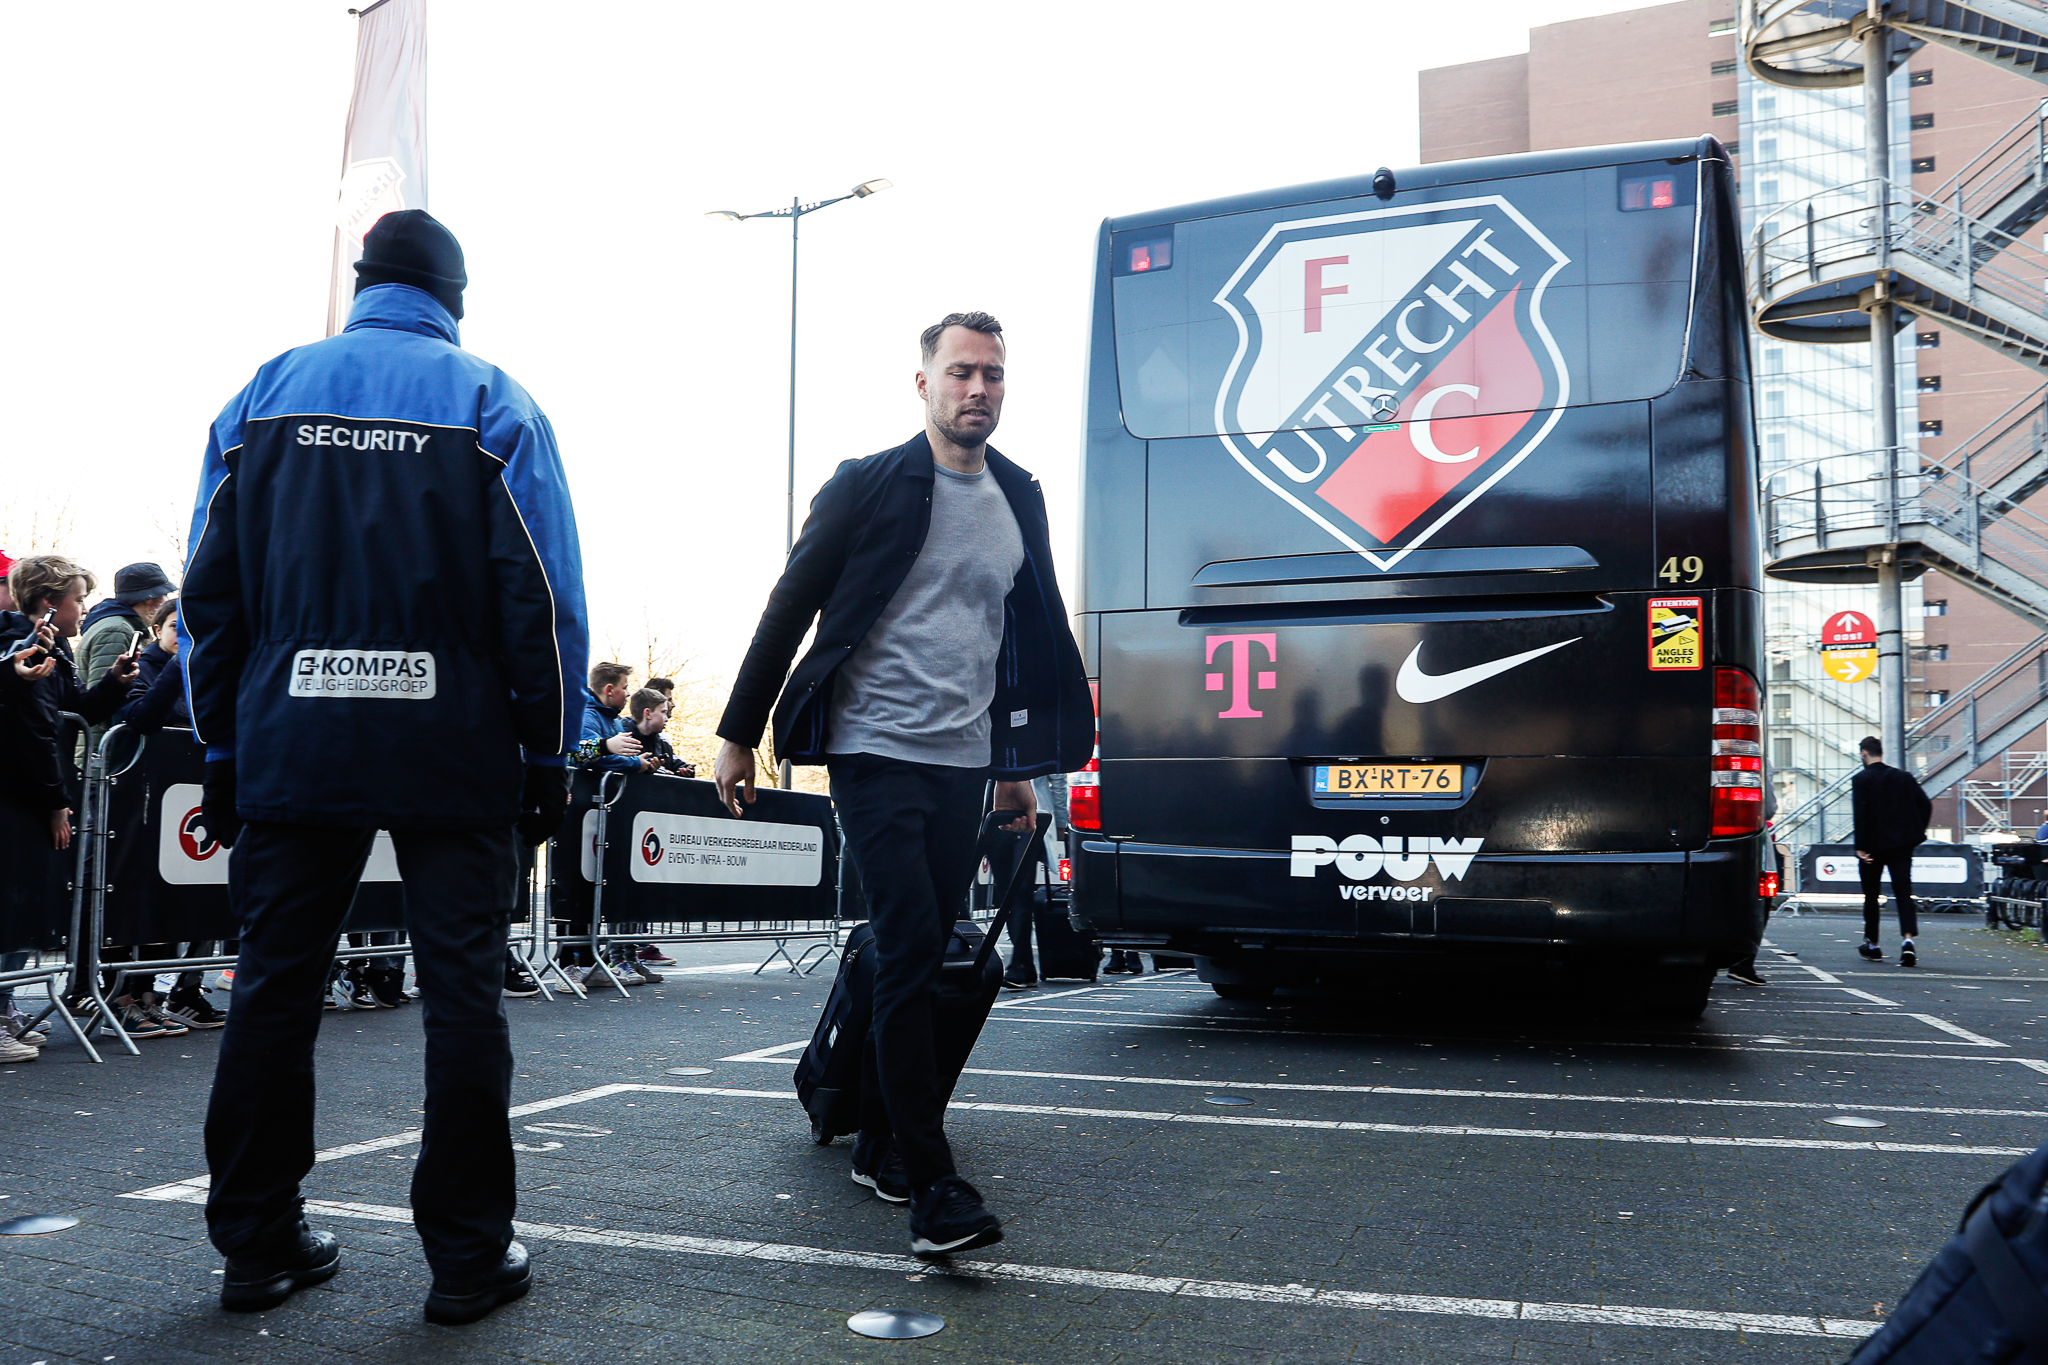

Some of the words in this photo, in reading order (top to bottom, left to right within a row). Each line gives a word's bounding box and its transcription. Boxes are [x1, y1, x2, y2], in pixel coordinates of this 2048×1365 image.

[1304, 255, 1349, 334] F
[1266, 227, 1520, 484] UTRECHT
[1409, 384, 1480, 464] C
[296, 424, 431, 454] SECURITY
[1658, 555, 1704, 584] 49
[1650, 599, 1700, 608] ATTENTION
[1833, 632, 1862, 641] oost
[1656, 648, 1694, 656] ANGLES
[1658, 656, 1693, 664] MORTS
[1829, 650, 1867, 659] noord
[321, 656, 428, 678] KOMPAS
[296, 678, 429, 693] VEILIGHEIDSGROEP
[1316, 781, 1328, 789] NL
[1338, 768, 1450, 789] BX-RT-76
[669, 833, 702, 846] BUREAU
[703, 836, 777, 850] VERKEERSREGELAAR
[778, 841, 818, 852] NEDERLAND
[668, 852, 695, 865] EVENTS
[701, 854, 721, 865] INFRA
[727, 856, 748, 867] BOUW
[1290, 834, 1486, 882] POUW
[1339, 885, 1434, 902] vervoer
